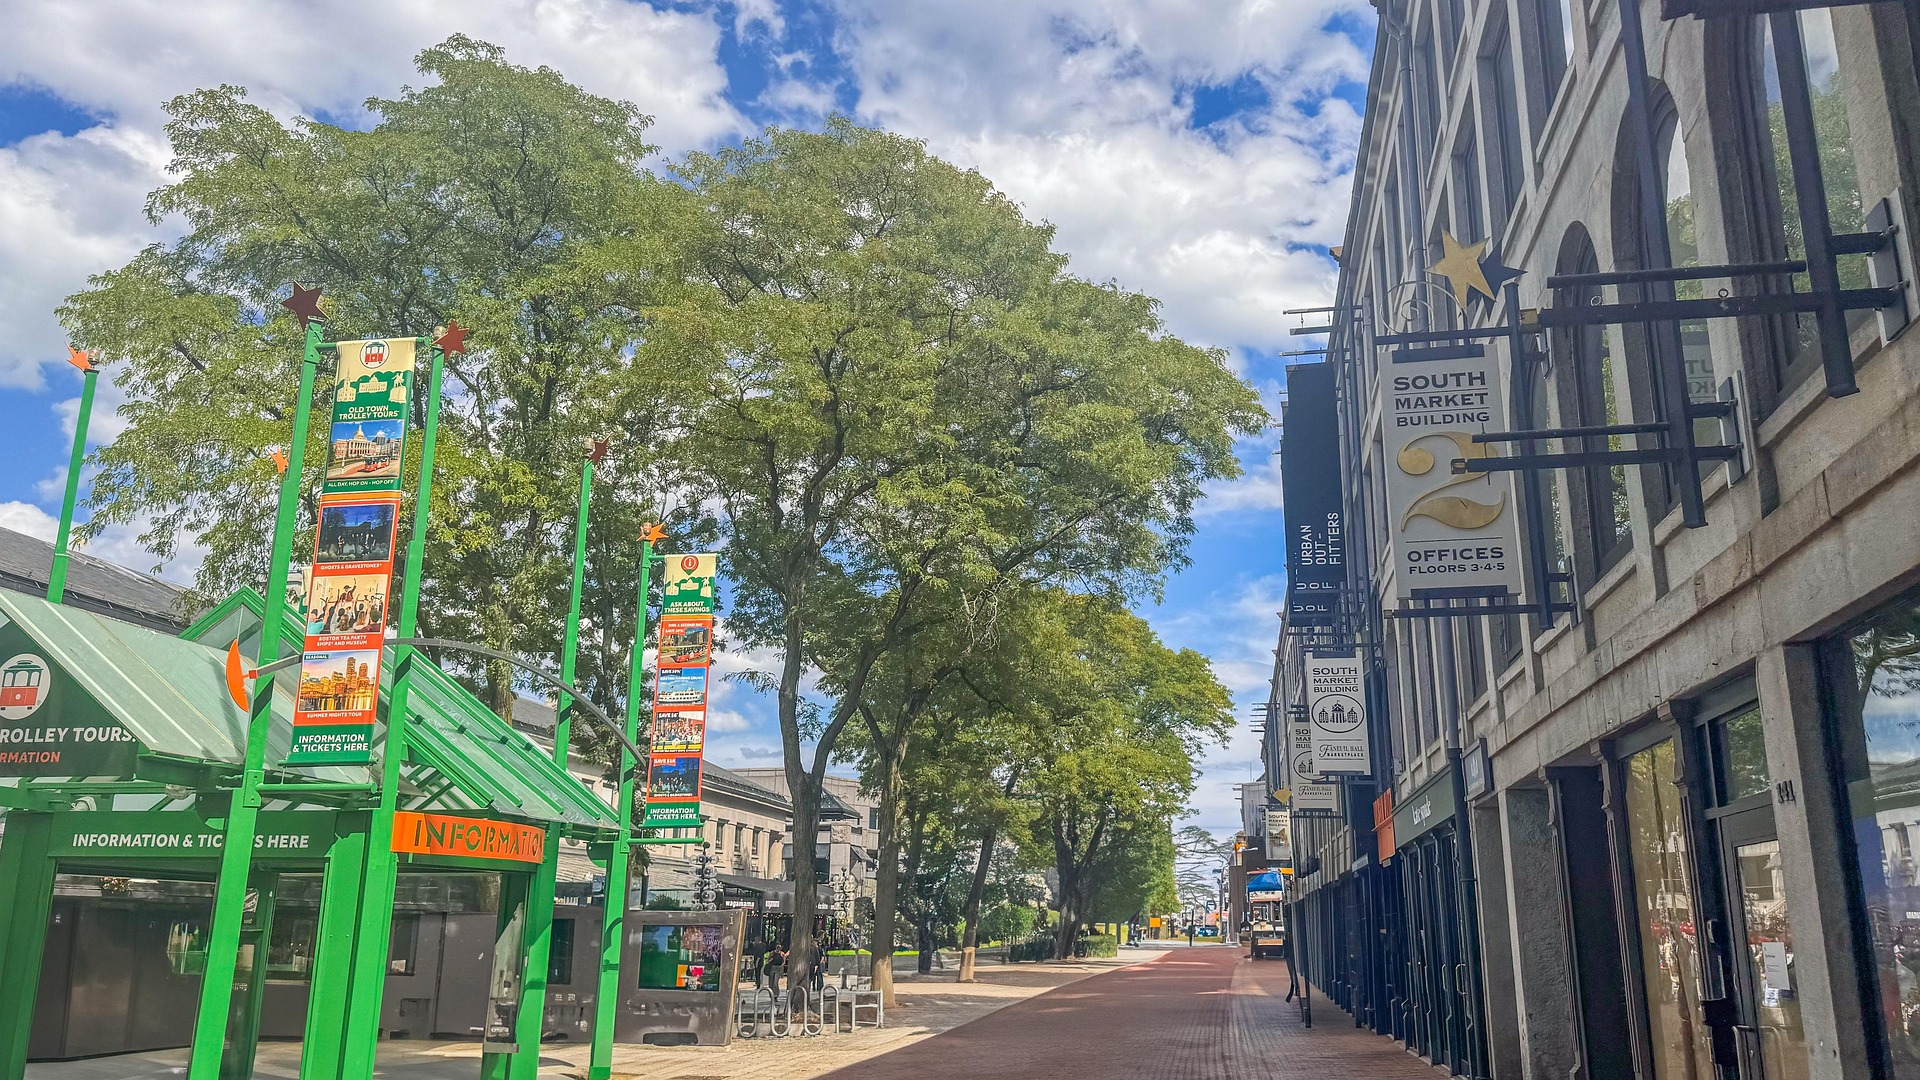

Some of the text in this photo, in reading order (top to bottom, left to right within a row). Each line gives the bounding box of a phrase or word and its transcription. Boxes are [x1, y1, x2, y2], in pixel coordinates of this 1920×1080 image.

[1394, 371, 1486, 390] SOUTH
[1396, 392, 1488, 410] MARKET
[1396, 412, 1490, 427] BUILDING
[1397, 431, 1506, 532] 2
[1300, 525, 1313, 565] URBAN
[1328, 512, 1340, 564] FITTERS
[1315, 533, 1326, 565] OUT-
[1407, 547, 1504, 562] OFFICES
[1409, 564, 1466, 574] FLOORS
[1312, 667, 1357, 675] SOUTH
[299, 734, 365, 744] INFORMATION
[302, 744, 341, 752] TICKETS
[344, 743, 368, 751] HERE
[72, 834, 309, 848] INFORMATION & TICS HERE
